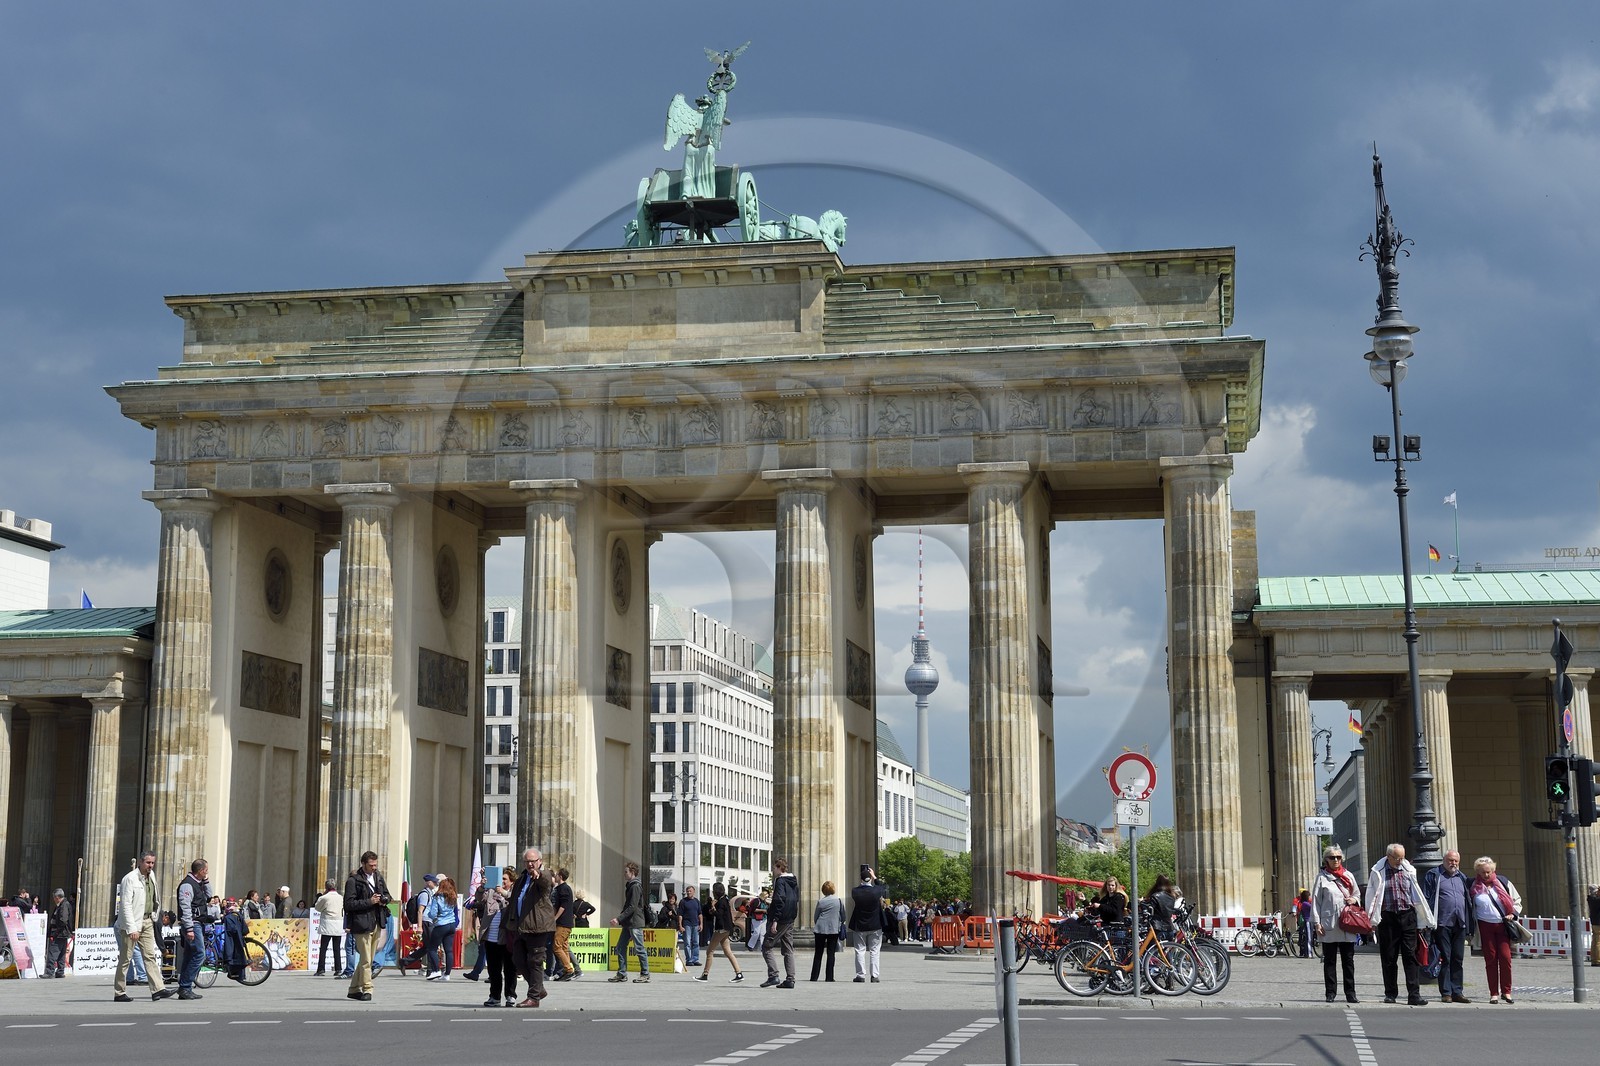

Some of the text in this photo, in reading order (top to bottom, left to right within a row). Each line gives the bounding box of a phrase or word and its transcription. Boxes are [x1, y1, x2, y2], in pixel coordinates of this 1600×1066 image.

[1544, 548, 1582, 558] HOTEL
[658, 947, 674, 958] NOW!
[587, 953, 607, 964] THEM
